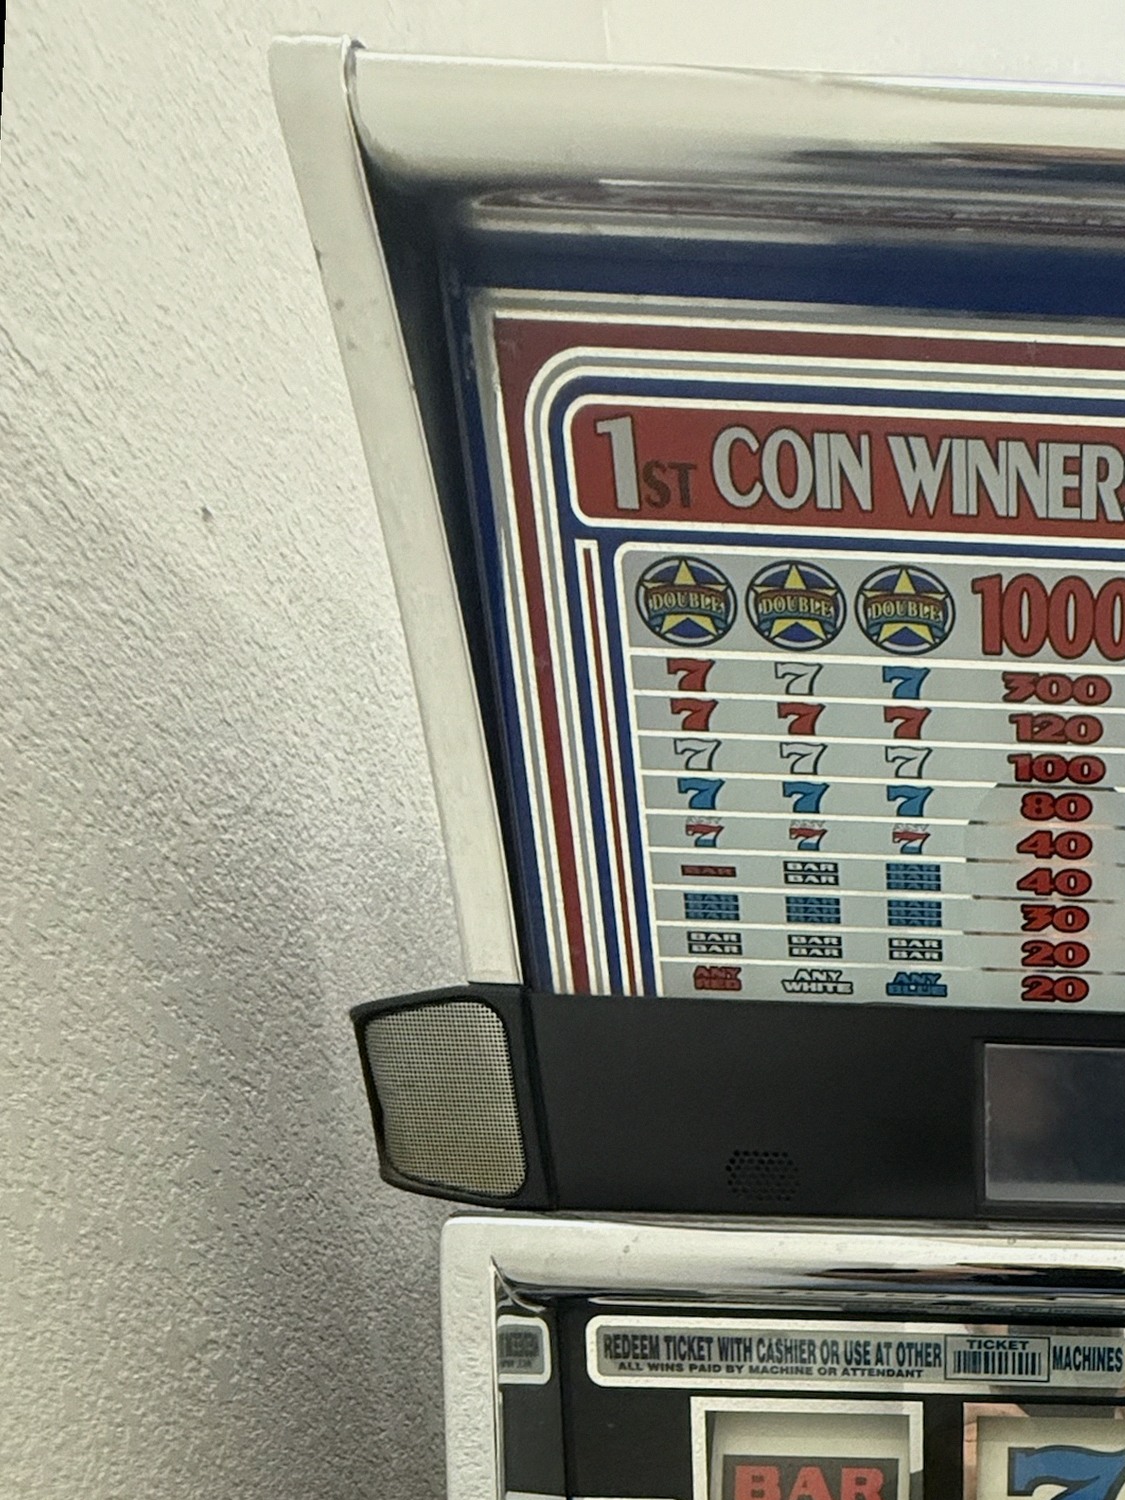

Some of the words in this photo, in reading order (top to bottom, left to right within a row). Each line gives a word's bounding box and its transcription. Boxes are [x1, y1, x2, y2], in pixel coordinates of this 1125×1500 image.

[710, 425, 873, 511] COIN
[649, 591, 725, 615] DOUBLE
[759, 596, 834, 619] DOUBLE
[869, 600, 943, 623] DOUBLE
[666, 657, 715, 692] 7
[774, 661, 823, 696] 7
[882, 666, 930, 700] 7
[1001, 671, 1112, 706] 300
[1008, 712, 1104, 744] 120
[1007, 754, 1107, 785] 100
[1019, 791, 1093, 822] 80
[1016, 830, 1093, 860] 40
[1016, 867, 1092, 896] 40
[1019, 904, 1090, 933] 30
[690, 932, 739, 942] BAR
[790, 936, 840, 945] BAR
[891, 939, 940, 949] BAR
[691, 944, 739, 954] BAR
[791, 947, 840, 958] BAR
[892, 951, 940, 960] BAR
[1019, 939, 1090, 969] 20
[782, 979, 854, 994] WHITE
[795, 969, 843, 981] ANY
[1019, 975, 1090, 1003] 20
[604, 1334, 660, 1360] REDEEM
[665, 1336, 713, 1361] TICKET
[717, 1337, 752, 1362] WITH
[757, 1338, 816, 1365] CASHIER
[820, 1340, 840, 1365] OR
[844, 1340, 871, 1366] USE
[875, 1341, 893, 1367] AT
[896, 1342, 942, 1368] OTHER
[1052, 1345, 1124, 1372] MACHINES
[966, 1339, 1029, 1350] TICKET
[618, 1361, 644, 1371] ALL
[647, 1362, 684, 1372] WINS
[689, 1364, 722, 1373] PAID
[726, 1364, 744, 1374] BY
[749, 1365, 813, 1376] MACHINE
[818, 1366, 838, 1376] OR
[841, 1367, 924, 1378] ATTENDANT
